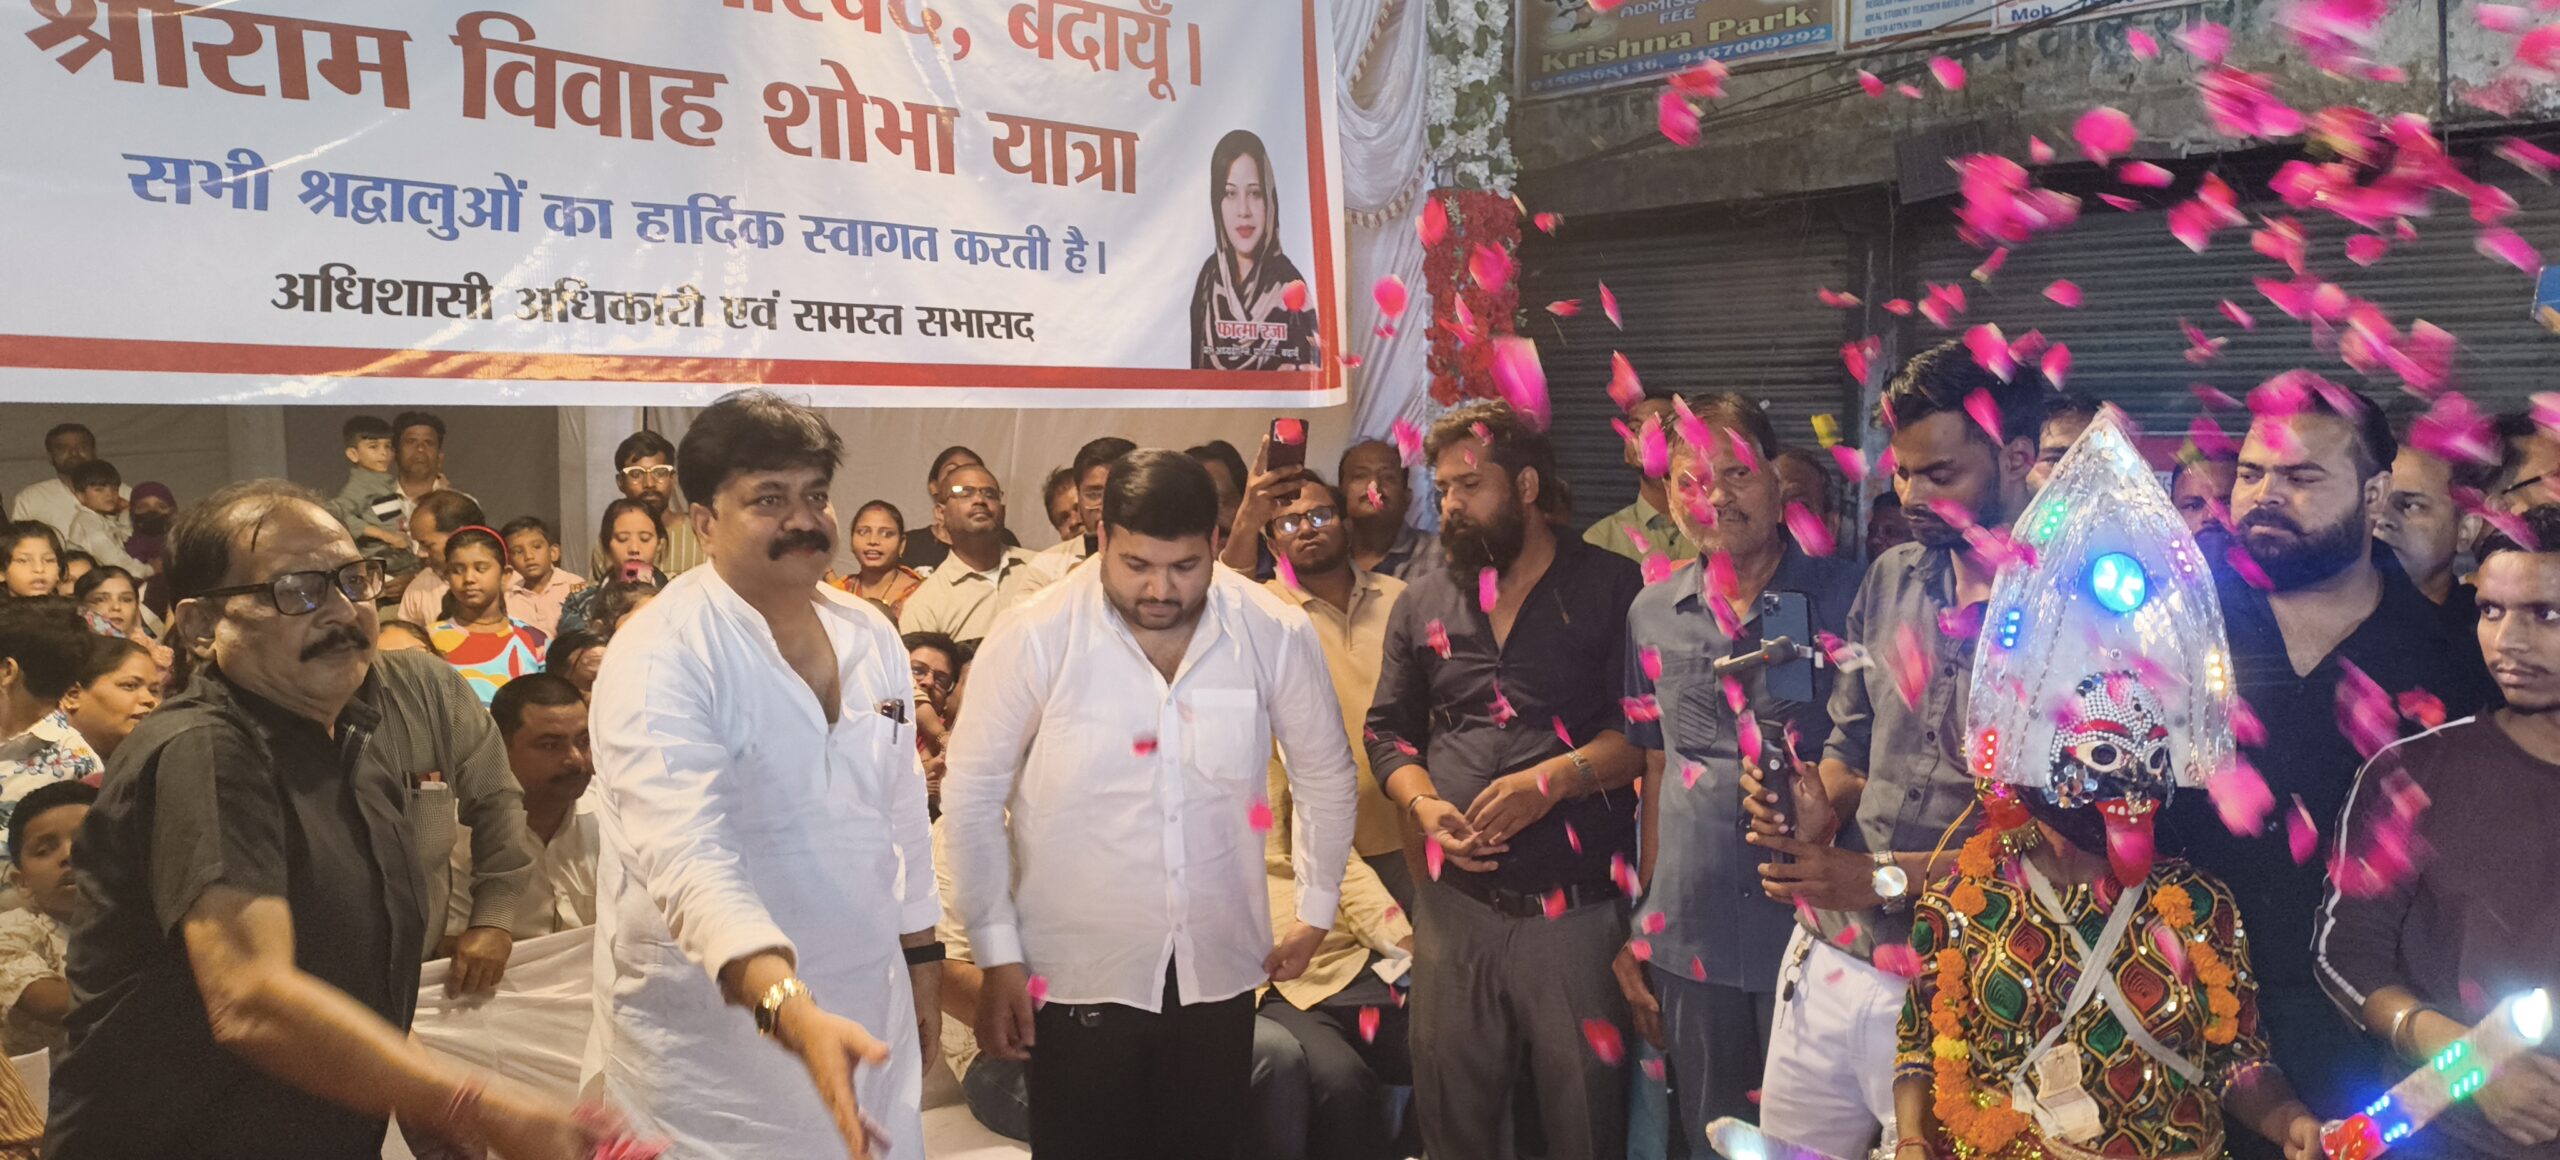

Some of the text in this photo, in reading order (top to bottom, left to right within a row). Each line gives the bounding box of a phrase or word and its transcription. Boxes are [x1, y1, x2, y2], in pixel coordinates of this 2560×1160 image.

[1541, 7, 1813, 73] Krishna Park
[1659, 7, 1696, 25] FEE
[25, 0, 1140, 194] श्रीराम विवाह शोभा यात्रा
[121, 147, 272, 212] सभी
[540, 192, 614, 241] का
[630, 192, 786, 249] हार्दिक
[798, 215, 939, 262] स्वागत
[950, 225, 1051, 271] करती
[270, 262, 1036, 342] अधिशासी अधिकारी एवं समस्त सभासद
